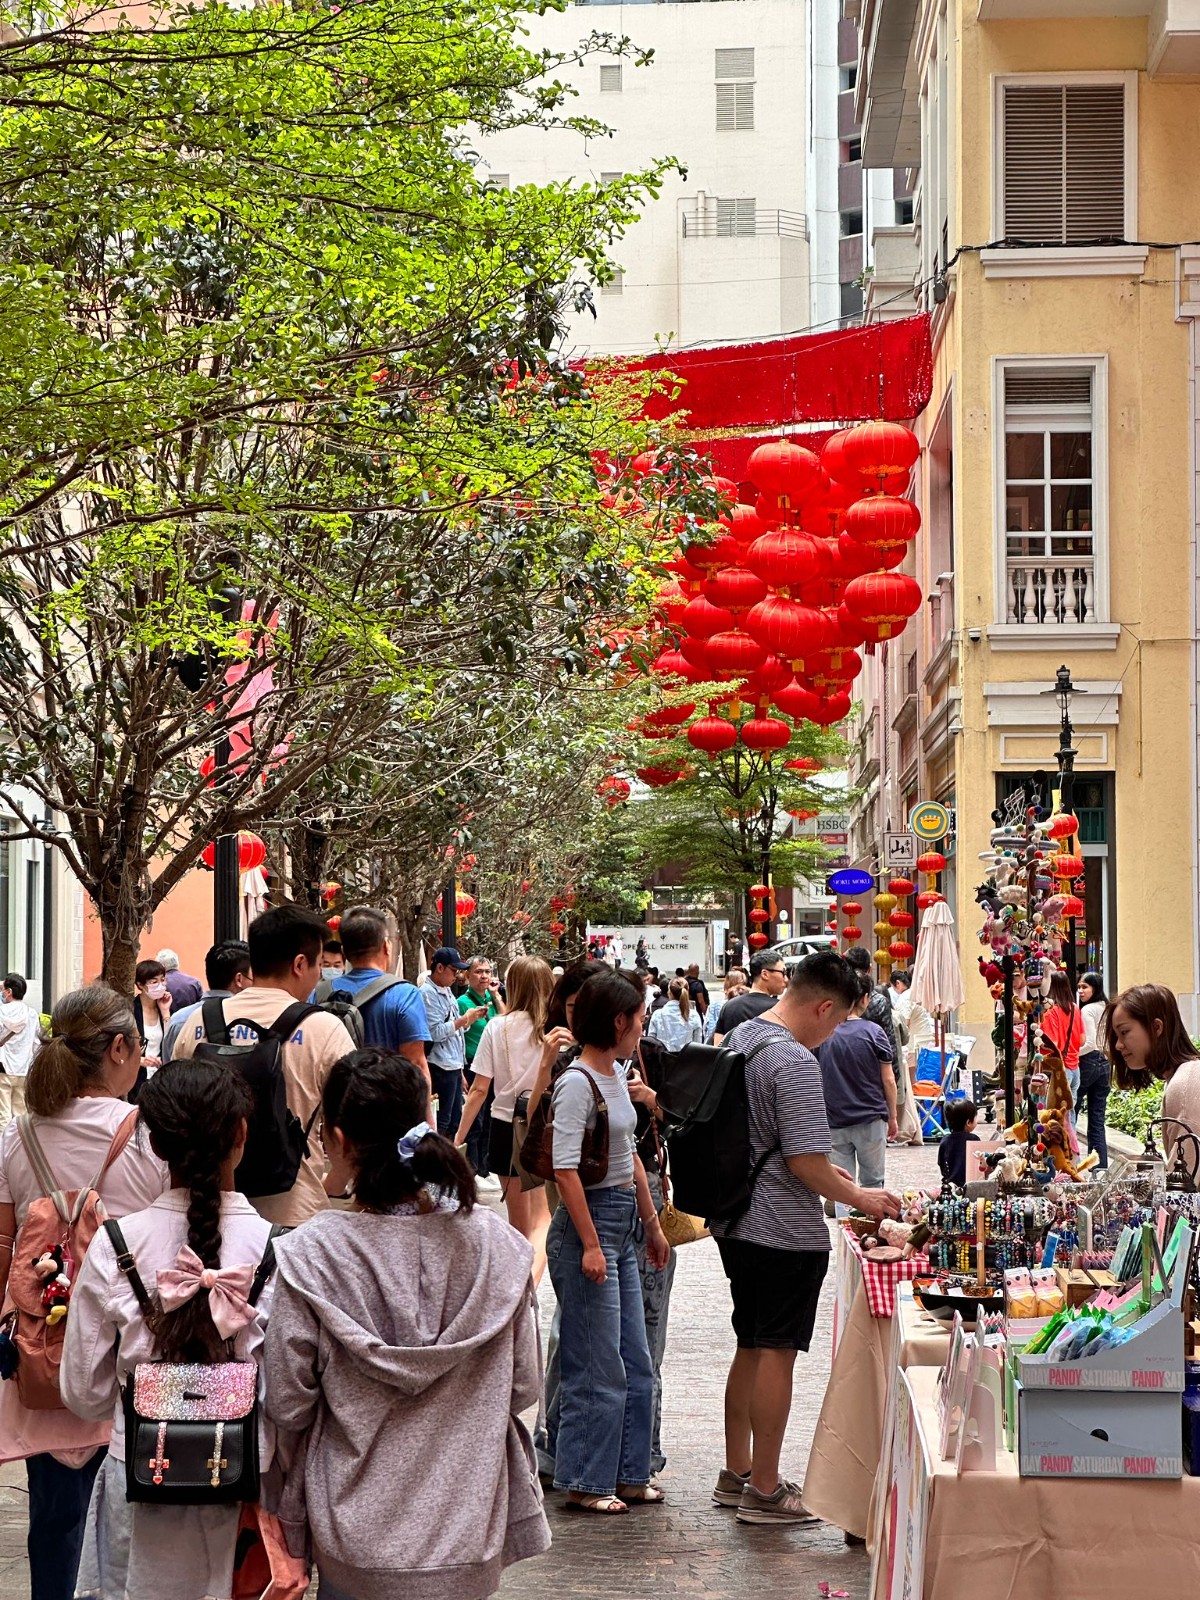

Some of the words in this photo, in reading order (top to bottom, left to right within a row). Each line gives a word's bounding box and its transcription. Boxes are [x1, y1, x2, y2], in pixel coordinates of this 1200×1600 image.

[817, 820, 848, 830] HSBC
[1081, 1368, 1132, 1388] SATURDAY
[1073, 1455, 1124, 1474] SATURDAY
